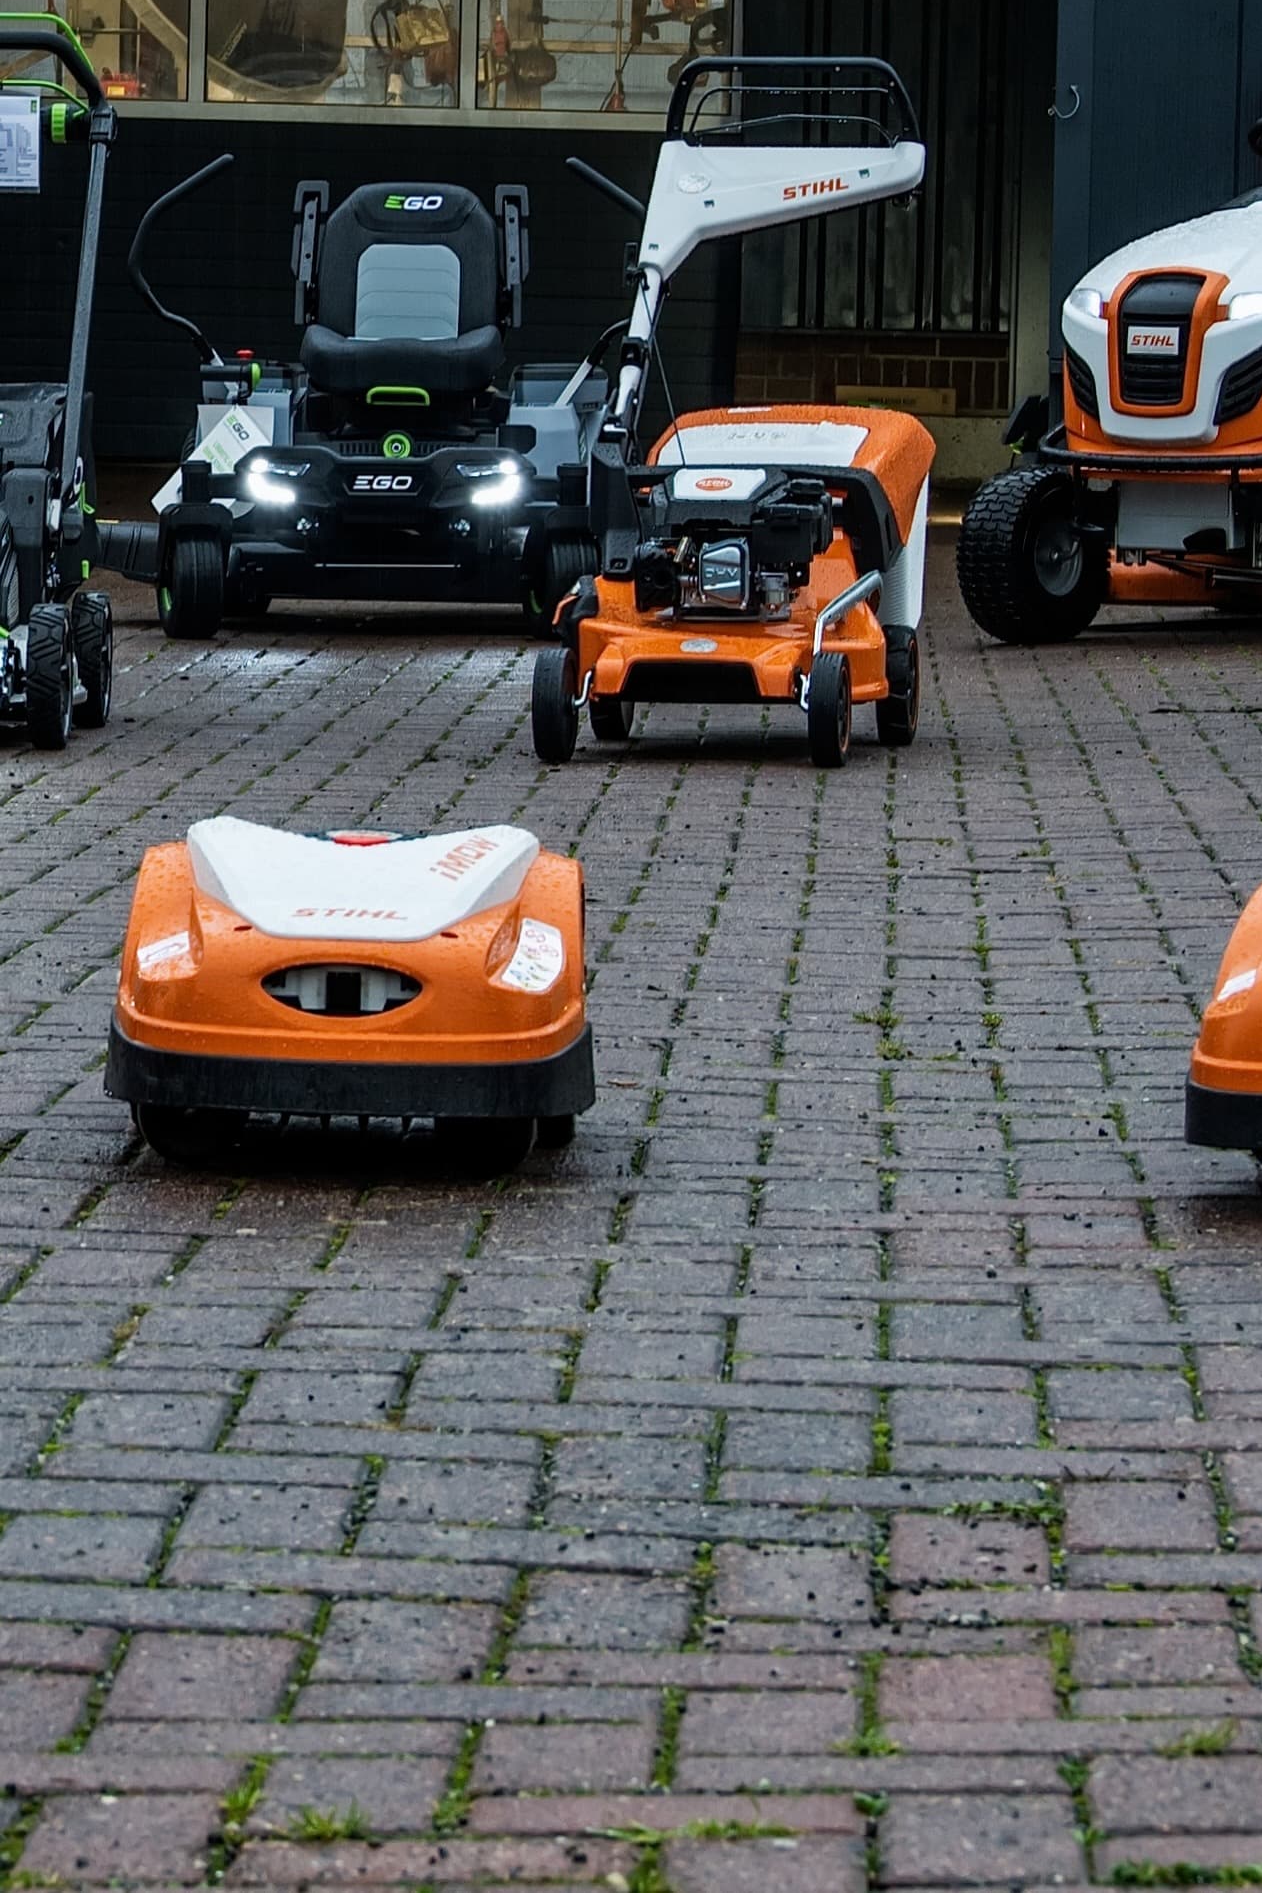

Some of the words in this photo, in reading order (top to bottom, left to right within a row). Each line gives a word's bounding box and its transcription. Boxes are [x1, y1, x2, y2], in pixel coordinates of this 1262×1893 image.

[783, 177, 849, 201] STIHL
[384, 195, 443, 210] EGO
[1130, 334, 1175, 347] STIHL
[226, 414, 250, 441] EGO
[353, 475, 413, 490] EGO
[291, 907, 408, 921] STIHL
